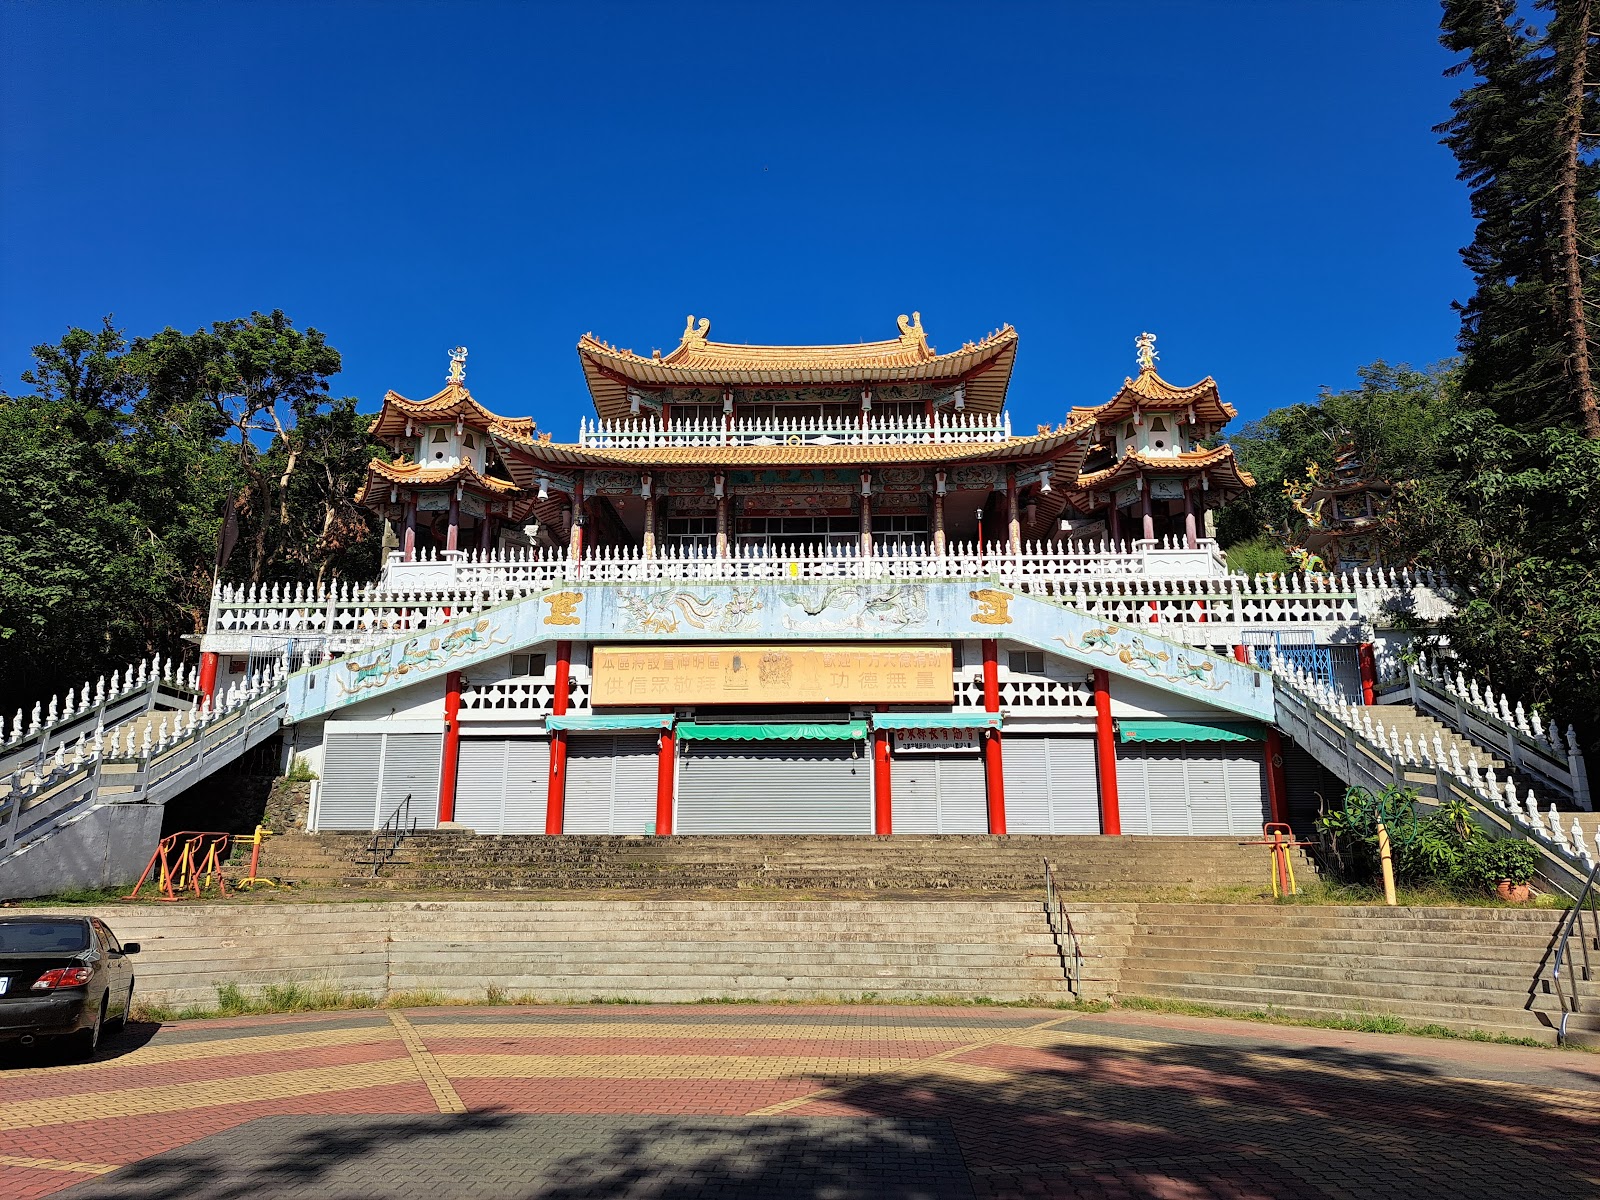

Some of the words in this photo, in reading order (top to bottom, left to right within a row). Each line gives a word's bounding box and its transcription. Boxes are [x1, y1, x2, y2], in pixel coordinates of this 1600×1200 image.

[602, 653, 720, 671] 本區將設置神明區
[822, 651, 942, 669] 歡迎十方大德捐助
[604, 675, 718, 695] 供信眾敬拜
[829, 670, 936, 690] 功德無量
